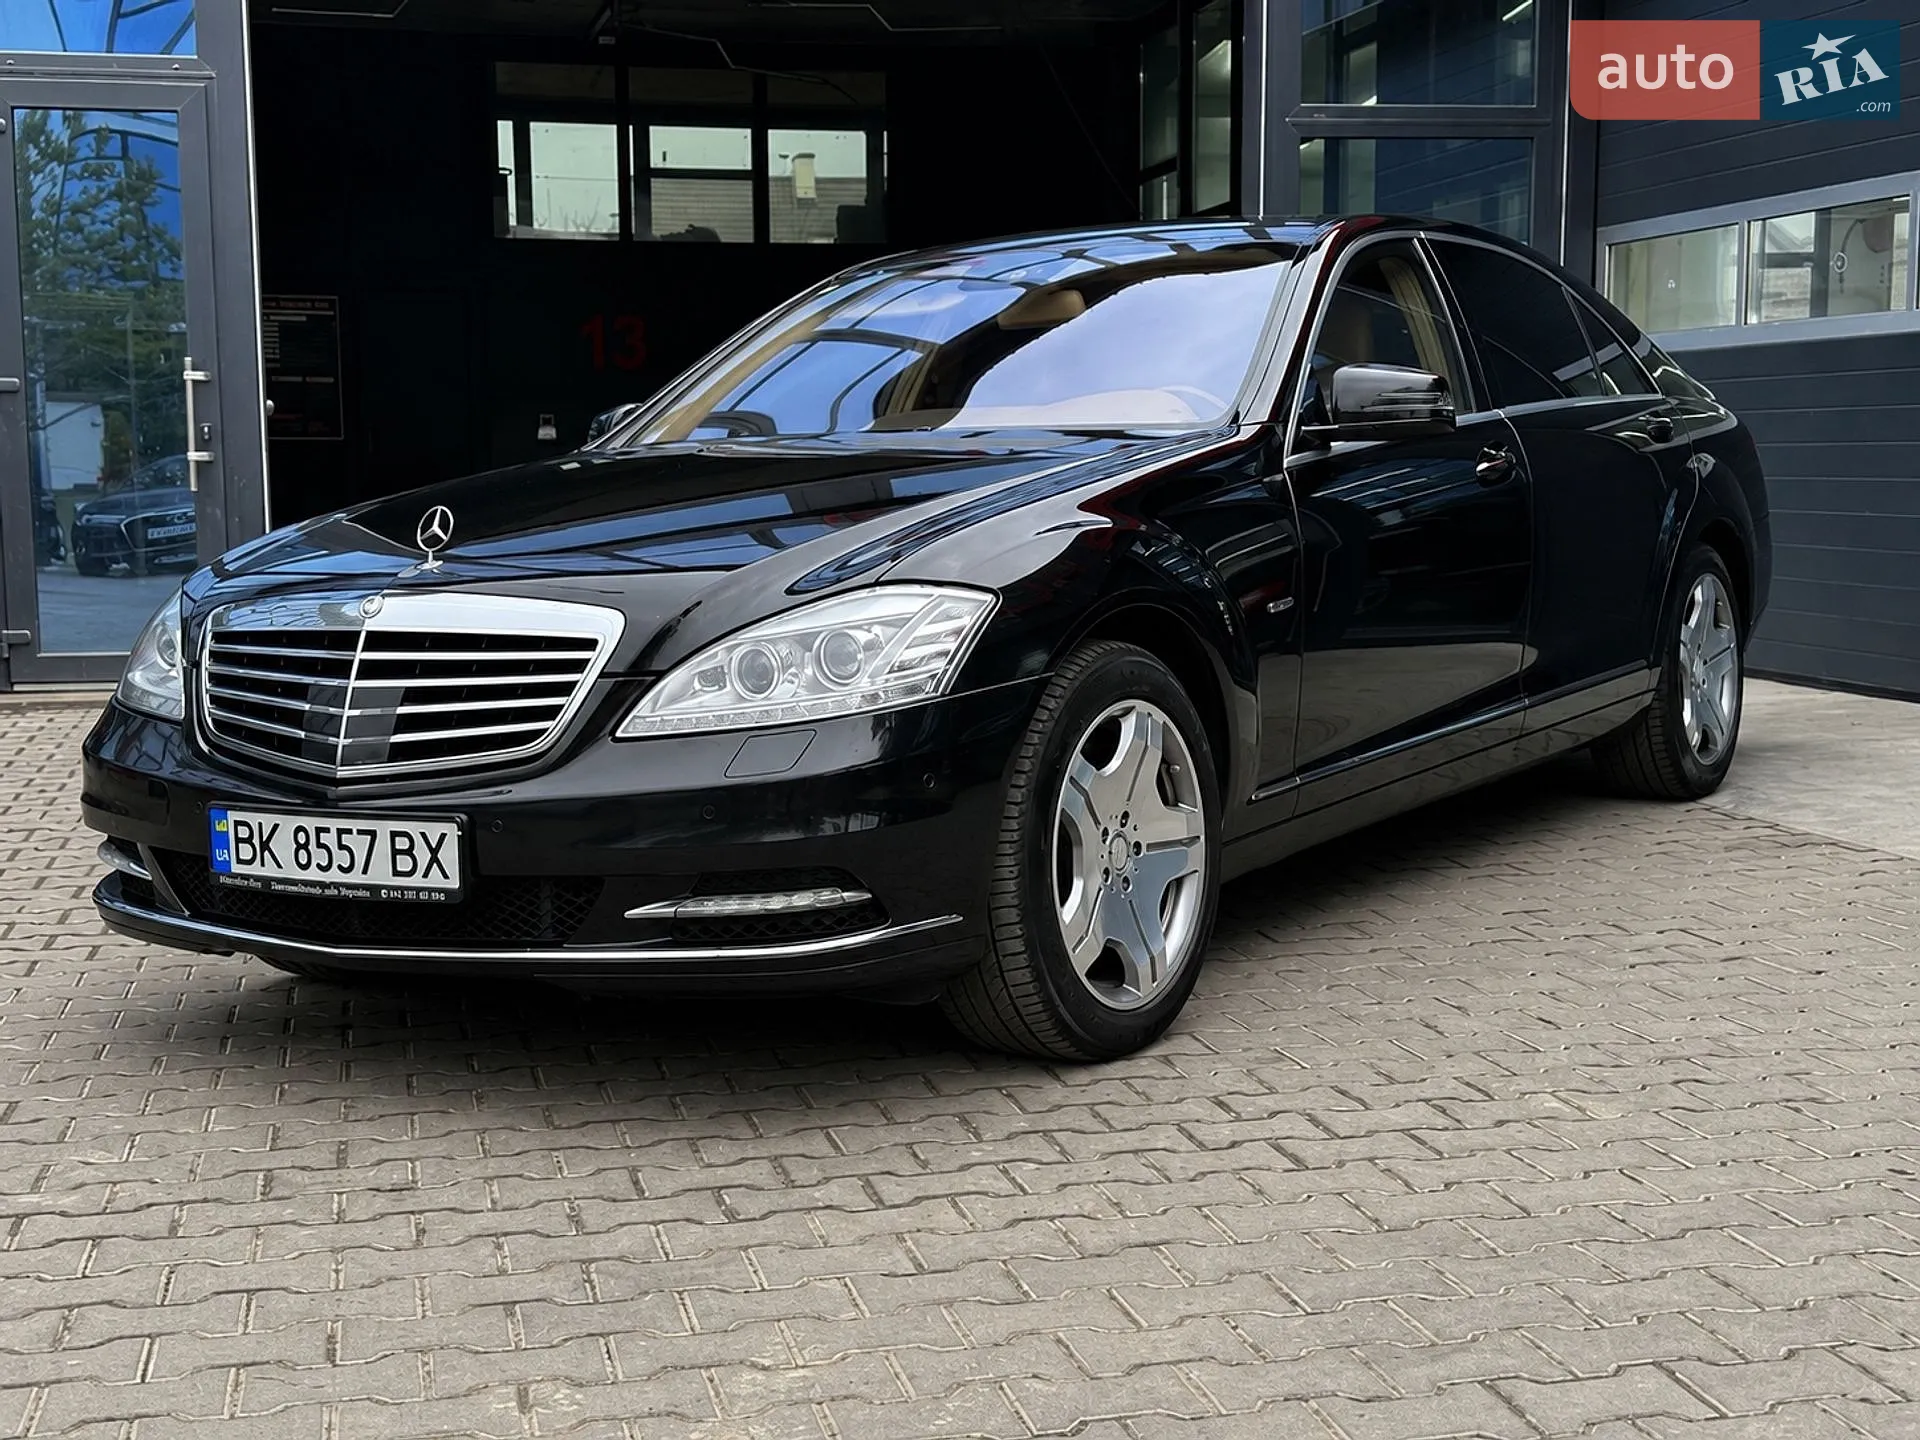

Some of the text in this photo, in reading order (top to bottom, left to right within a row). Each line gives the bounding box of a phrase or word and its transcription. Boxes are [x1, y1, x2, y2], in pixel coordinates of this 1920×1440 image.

[579, 313, 647, 371] 13
[215, 849, 230, 862] UA
[233, 819, 451, 881] BK 8557 BX
